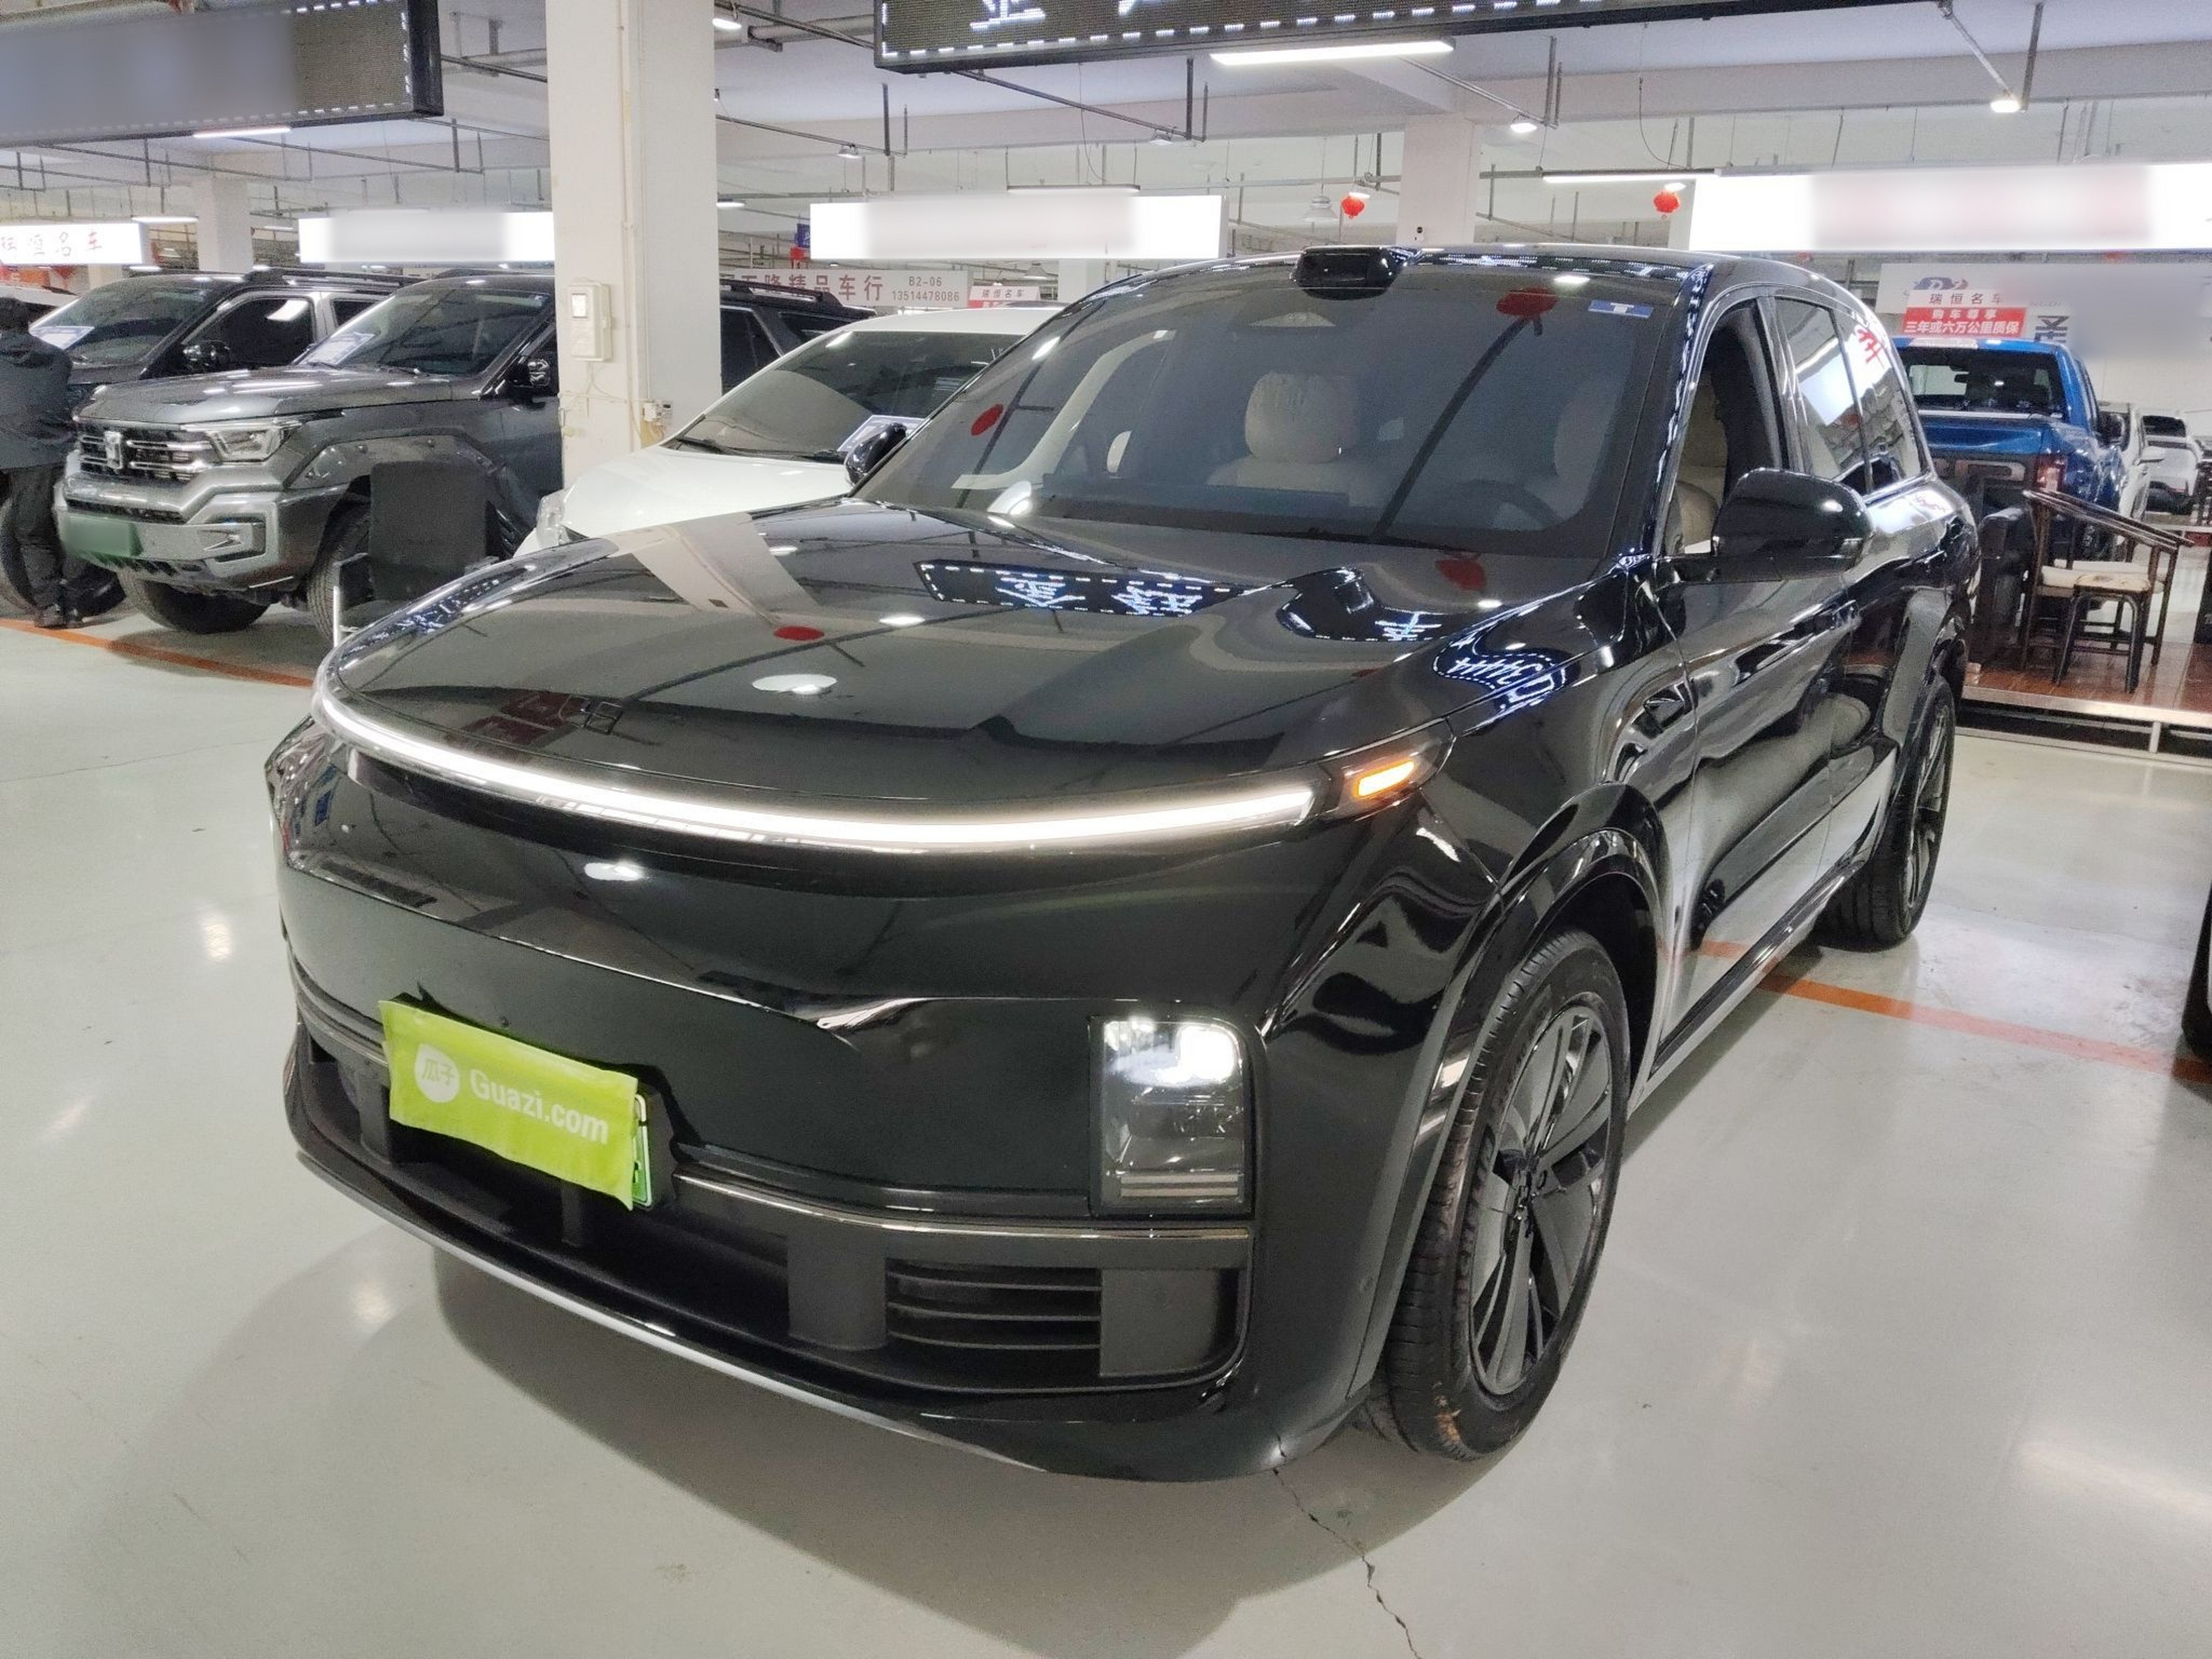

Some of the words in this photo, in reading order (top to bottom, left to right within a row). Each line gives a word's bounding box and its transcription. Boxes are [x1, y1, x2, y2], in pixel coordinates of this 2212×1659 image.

[908, 276, 942, 287] B2-06
[892, 291, 960, 302] 13514478086
[1929, 293, 2004, 305] 瑞恒名车
[1903, 321, 2020, 334] 三年或六万公里质保
[422, 1058, 455, 1086] 瓜子
[469, 1069, 609, 1145] Guazi.com
